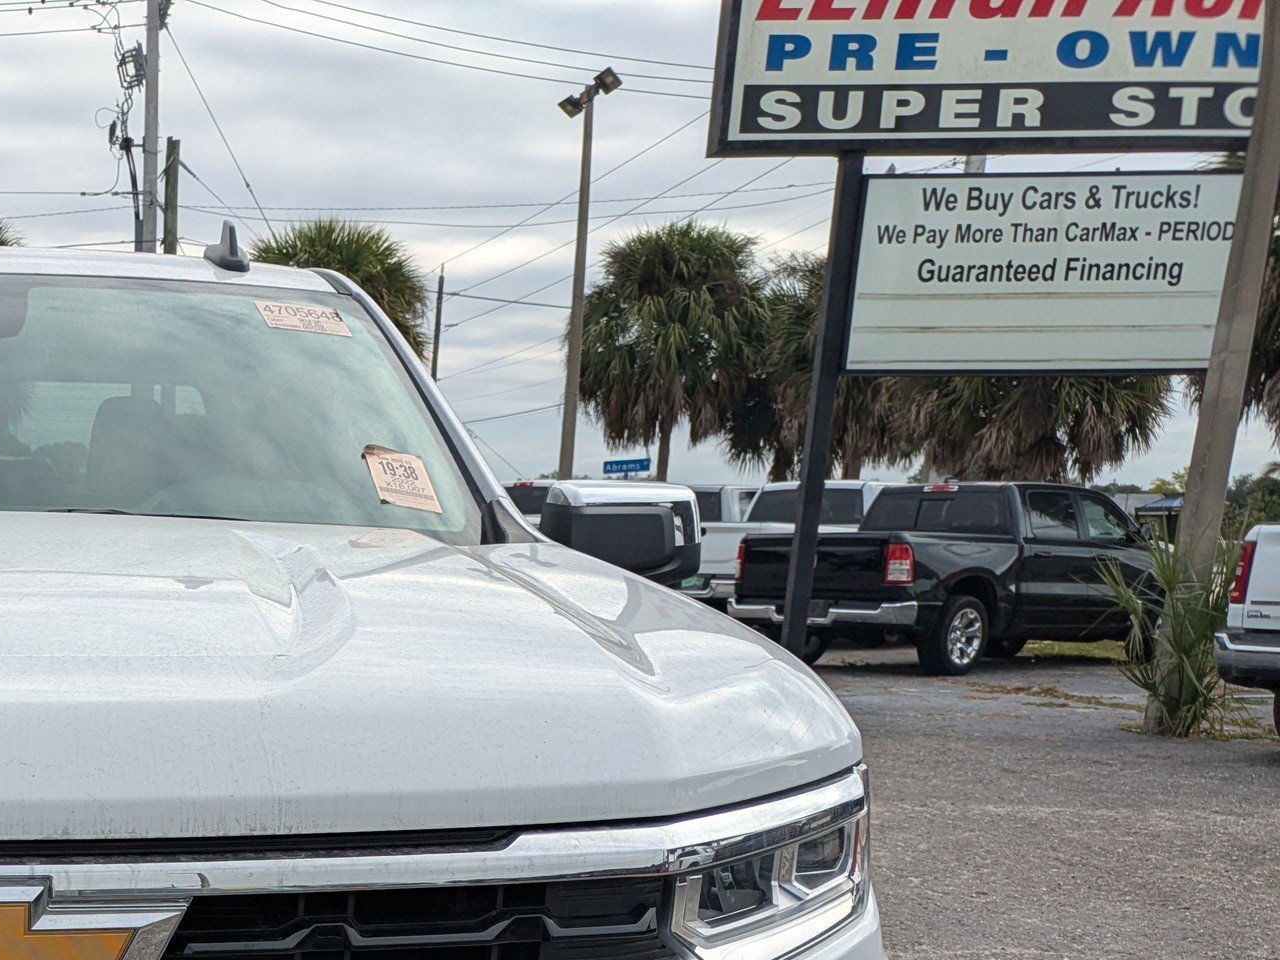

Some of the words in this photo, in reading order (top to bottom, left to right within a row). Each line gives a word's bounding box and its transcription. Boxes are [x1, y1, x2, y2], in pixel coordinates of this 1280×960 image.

[765, 33, 939, 71] PRE
[756, 88, 1044, 130] SUPER
[922, 187, 958, 212] We
[966, 186, 1014, 217] Buy
[1021, 185, 1077, 211] Cars
[1085, 184, 1102, 210] &
[1112, 184, 1201, 210] Trucks!
[877, 224, 907, 244] We
[912, 224, 950, 249] Pay
[955, 223, 1003, 244] More
[1011, 223, 1058, 243] Than
[1065, 222, 1140, 242] CarMax
[1157, 221, 1236, 242] PERIOD
[917, 257, 1057, 283] Guaranteed
[1064, 256, 1184, 287] Financing
[378, 460, 419, 481] 19:38
